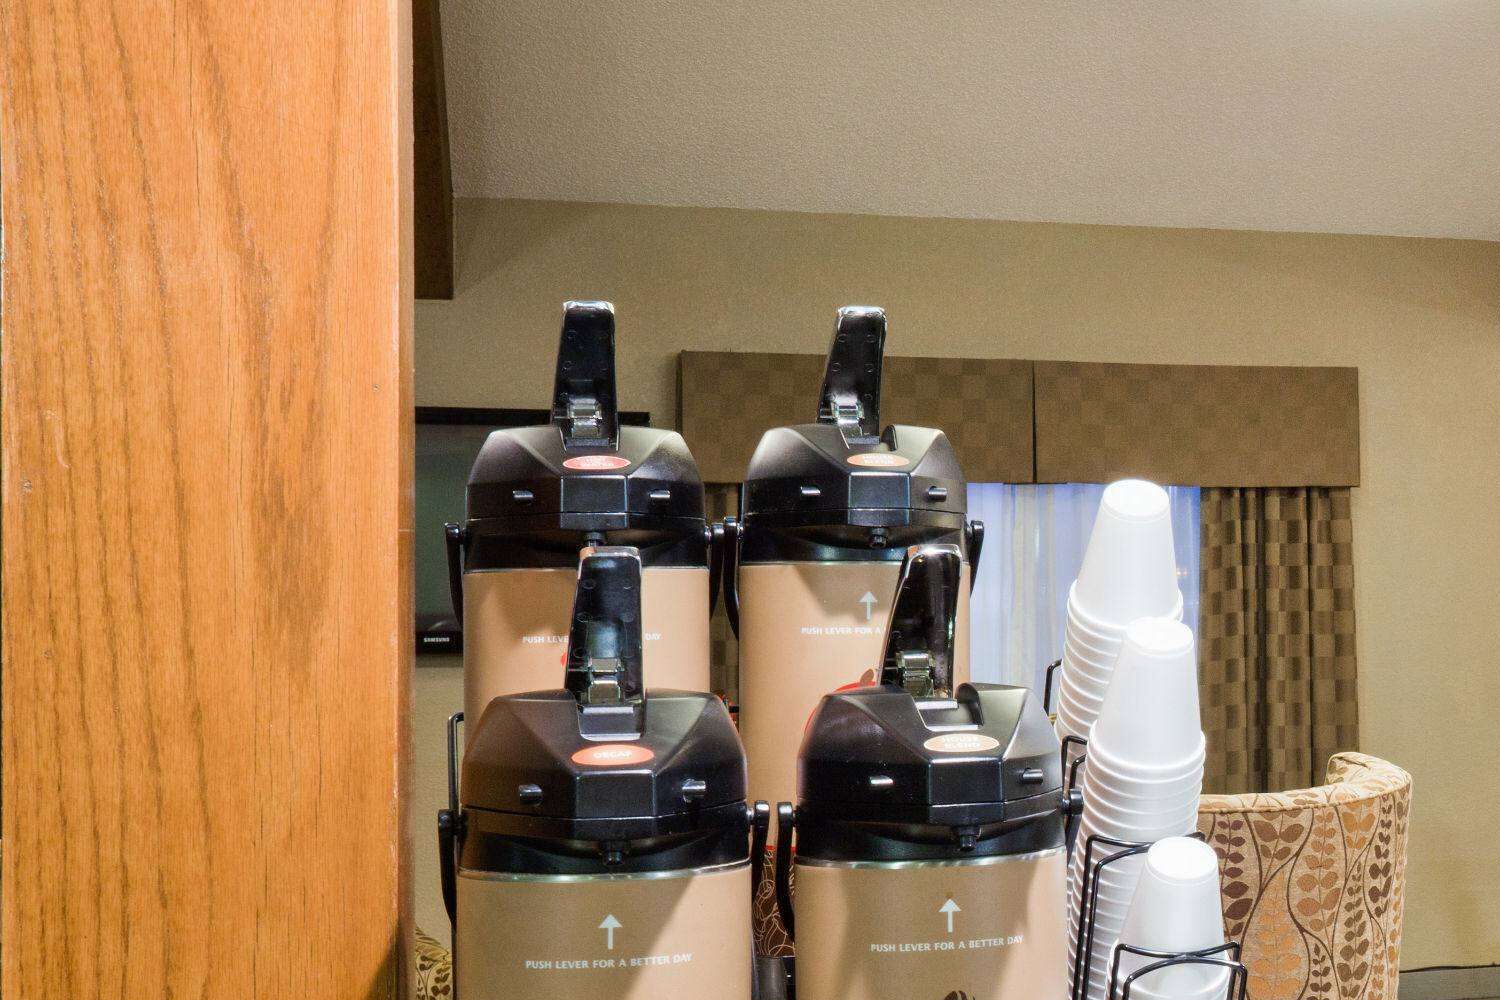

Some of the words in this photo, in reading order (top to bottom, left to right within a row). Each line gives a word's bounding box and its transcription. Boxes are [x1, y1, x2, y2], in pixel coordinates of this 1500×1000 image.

[522, 635, 544, 644] PUSH
[547, 635, 569, 643] LEVE
[871, 943, 896, 952] PUSH
[899, 942, 930, 952] LEVER
[934, 941, 955, 950] FOR
[958, 941, 966, 949] A
[969, 937, 1004, 948] BETTER
[1006, 934, 1024, 945] DAY
[525, 960, 552, 969] PUSH
[555, 960, 589, 969] LEVER
[592, 959, 616, 968] FOR
[618, 958, 627, 967] A
[630, 955, 671, 967] BETTER
[672, 952, 693, 963] DAY
